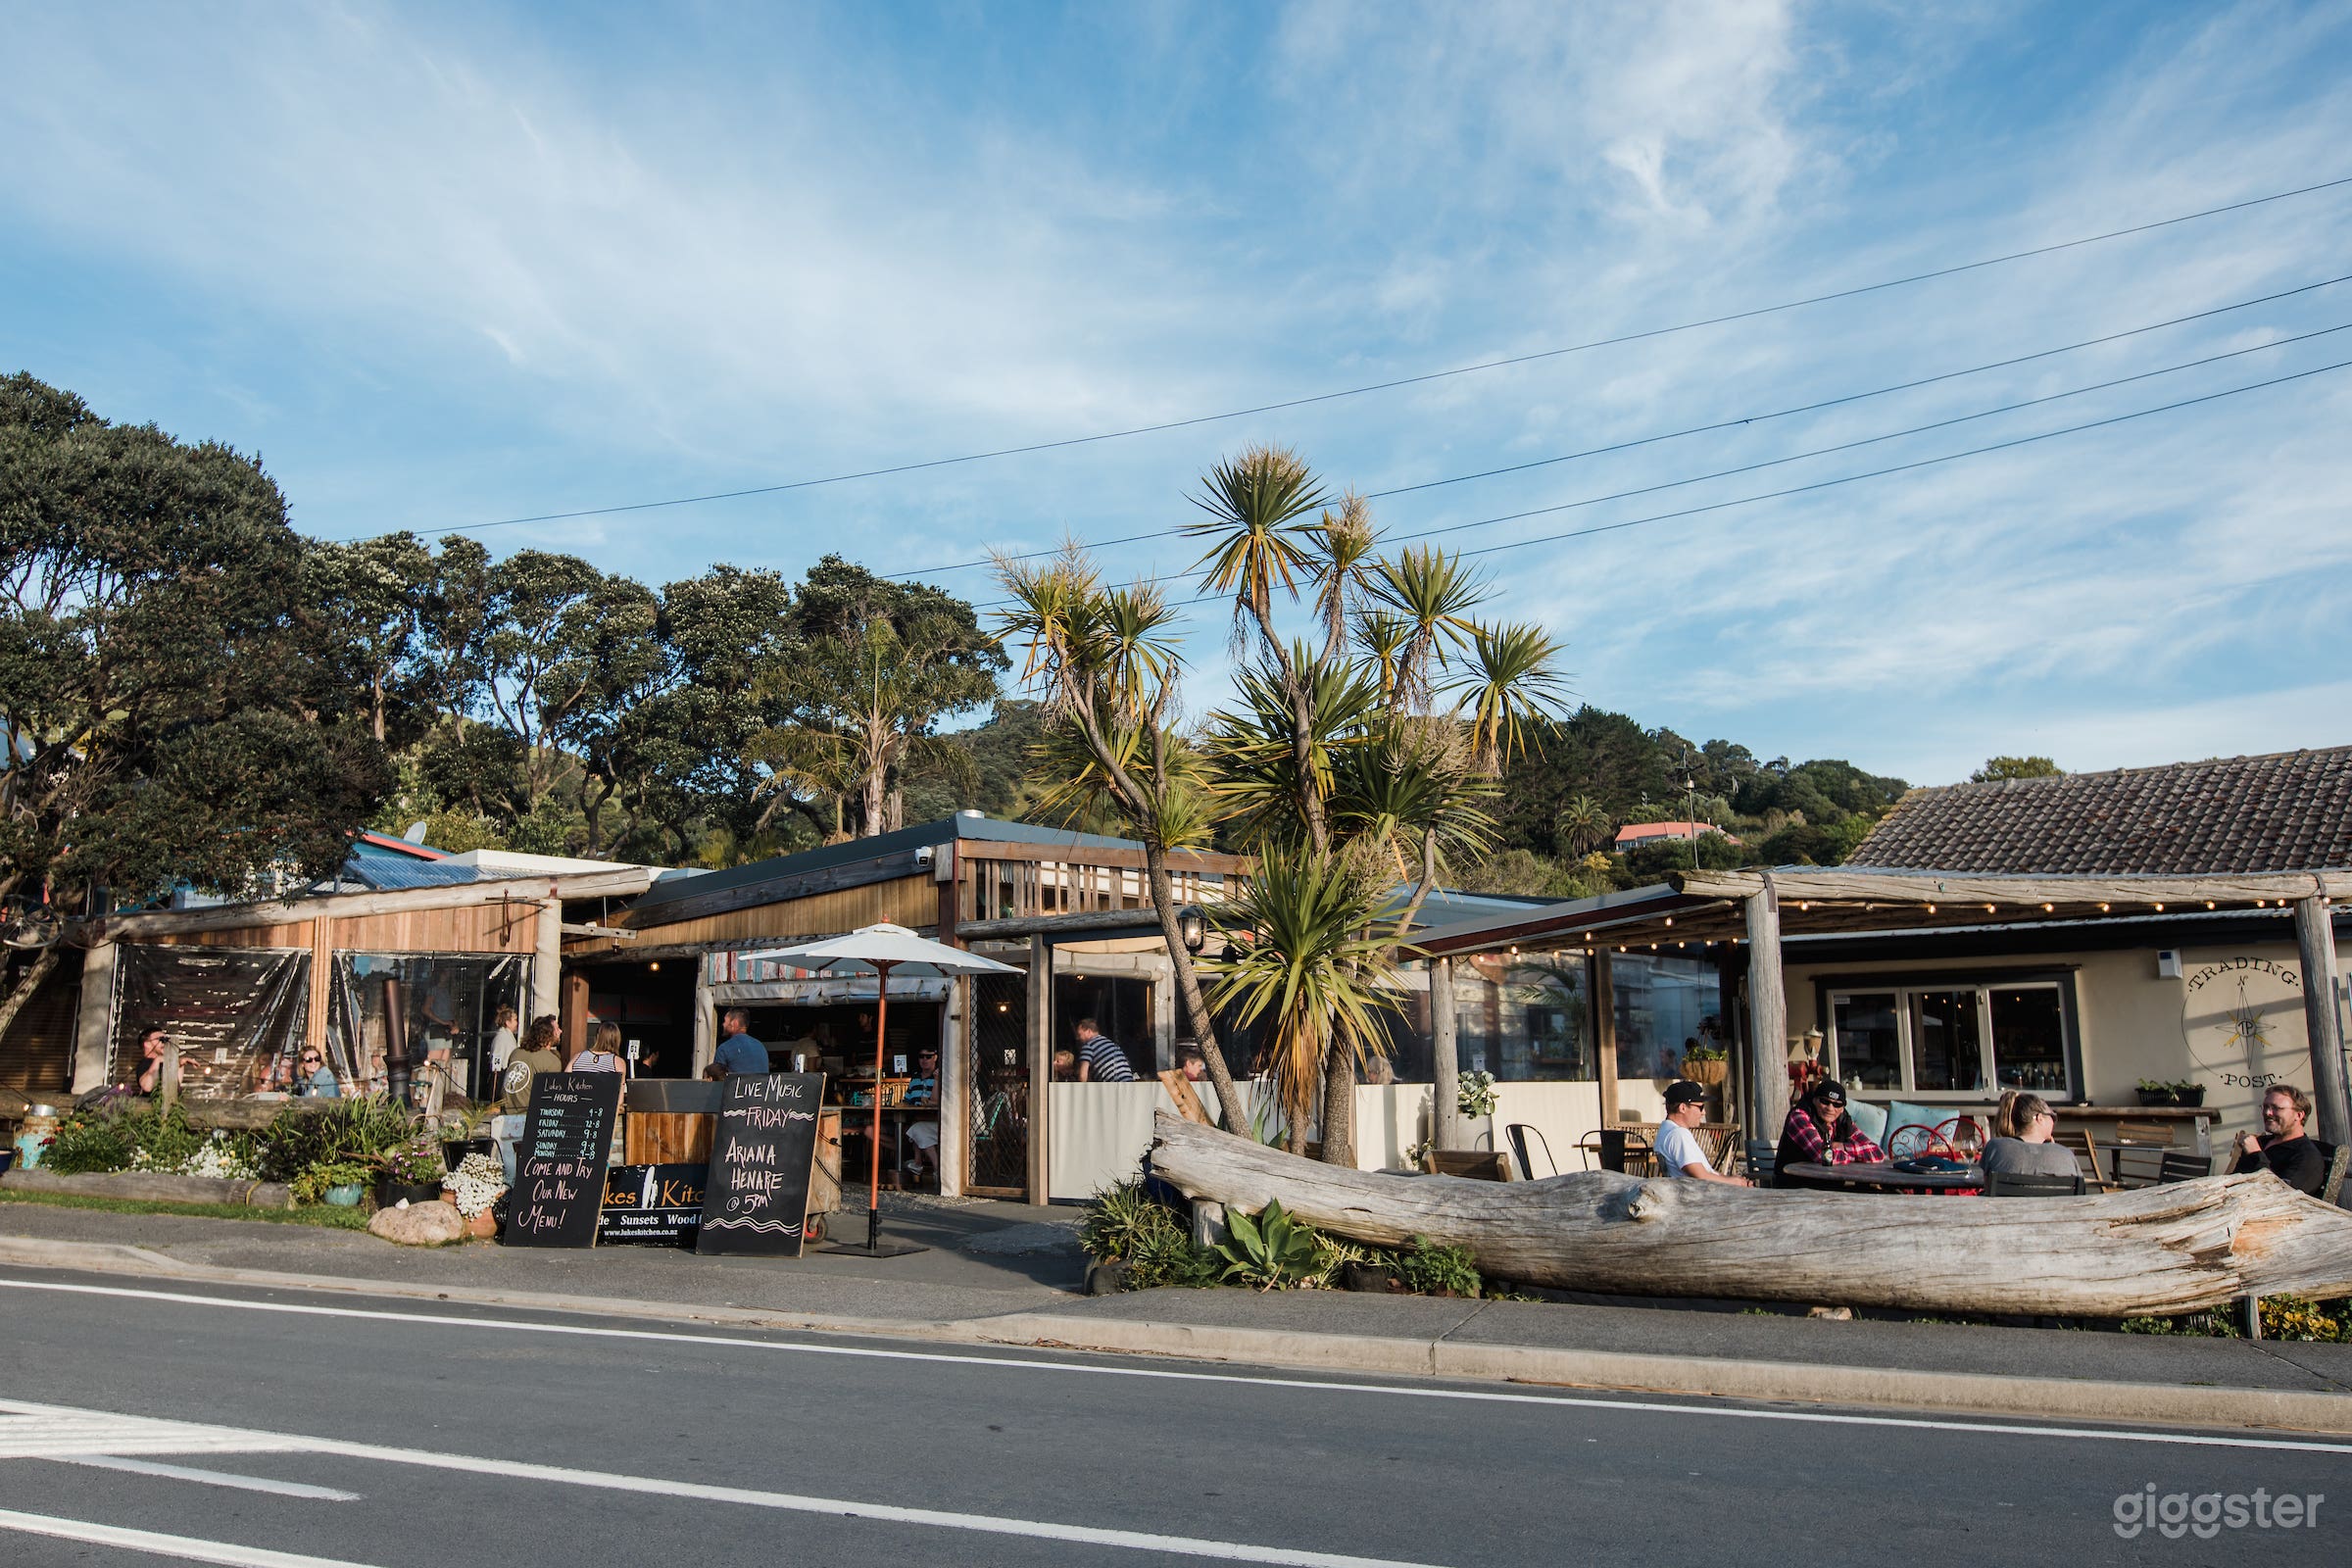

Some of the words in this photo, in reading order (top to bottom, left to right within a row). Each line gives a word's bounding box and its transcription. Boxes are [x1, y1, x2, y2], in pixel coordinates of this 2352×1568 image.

[2188, 956, 2297, 990] TRADING
[2224, 1074, 2277, 1088] POST
[554, 1094, 578, 1102] HOURS
[540, 1108, 564, 1117] THURSDAY
[746, 1106, 792, 1130] FRIDAY
[537, 1129, 565, 1139] SATURDAY
[535, 1141, 558, 1151] SUNDAY
[725, 1136, 776, 1168] ARIANA
[731, 1167, 784, 1200] HENARE
[604, 1182, 637, 1205] kes
[620, 1215, 660, 1226] Sunsets
[667, 1214, 697, 1225] Wood
